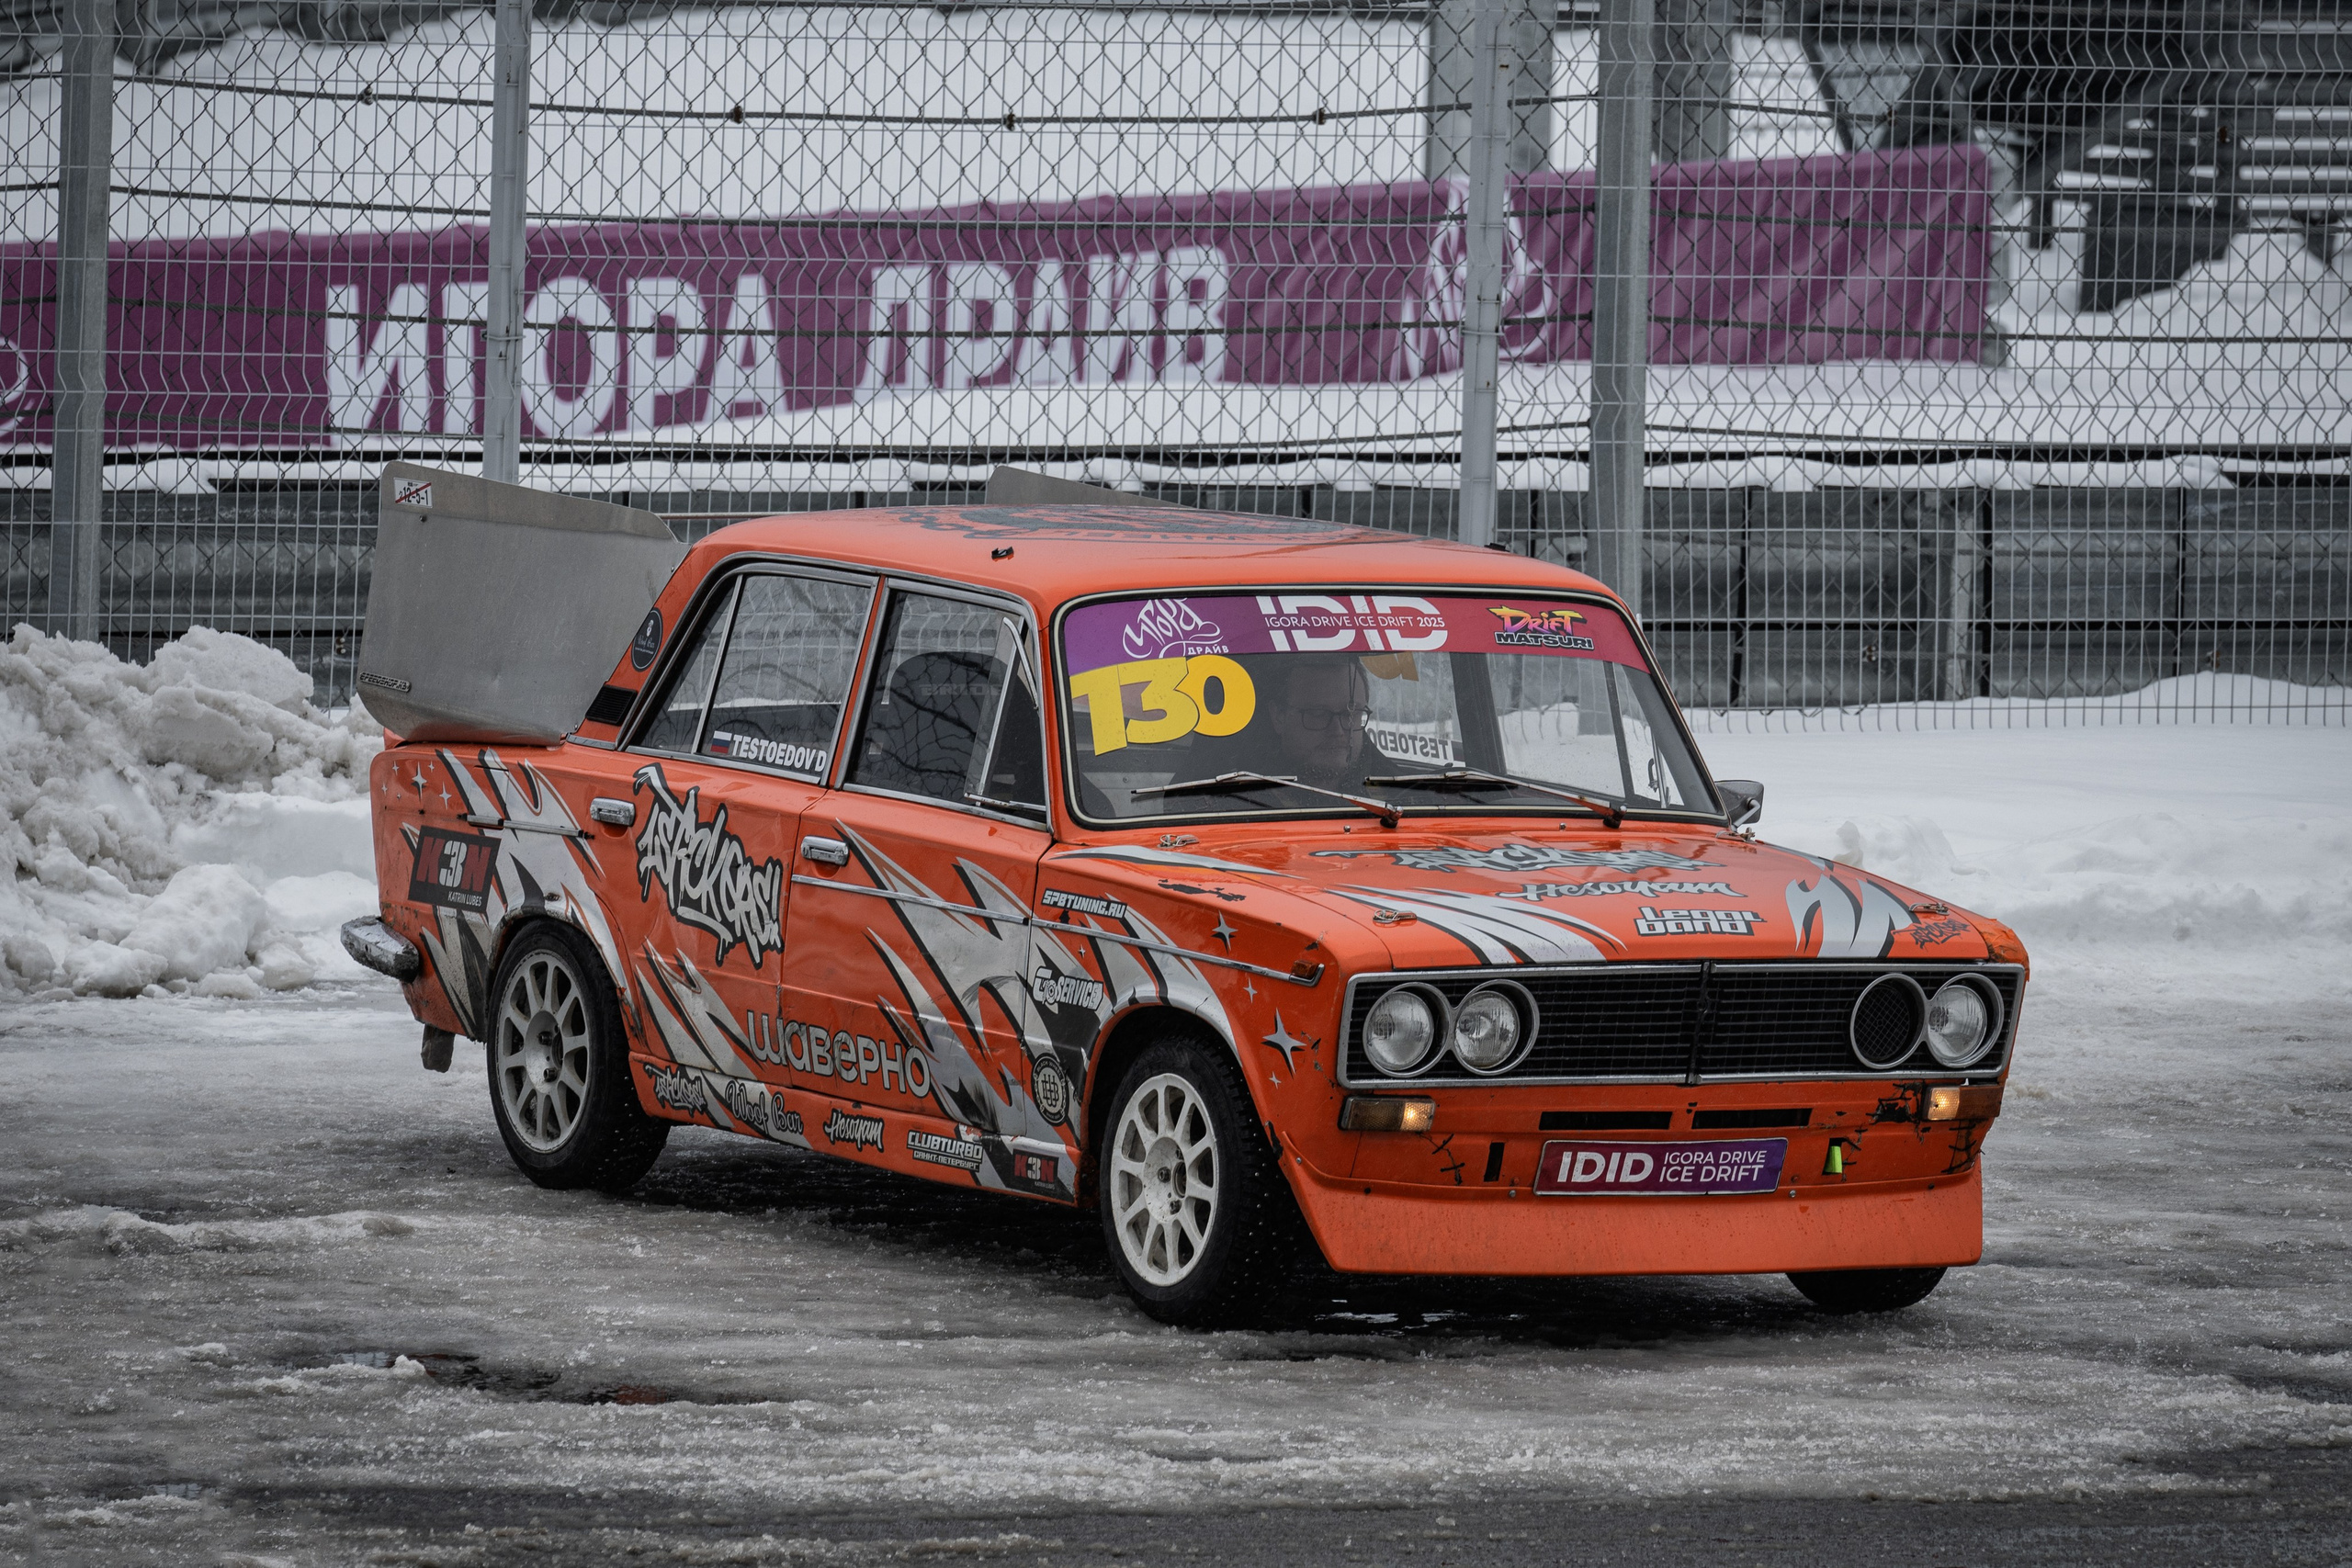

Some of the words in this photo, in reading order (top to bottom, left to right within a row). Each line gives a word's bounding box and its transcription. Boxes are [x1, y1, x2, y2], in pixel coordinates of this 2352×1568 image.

[325, 275, 787, 439] ИГОРА
[853, 245, 1231, 400] ДРАЙВ
[1265, 616, 1311, 627] IGORA
[1311, 616, 1352, 627] DRIVE
[1354, 616, 1376, 627] ICE
[1378, 616, 1414, 627] DRIFT
[1417, 616, 1445, 627] 2025
[1187, 644, 1229, 655] ДРАЙВ
[1495, 632, 1595, 650] MATSURI
[1069, 654, 1257, 756] 130
[732, 734, 817, 770] TESTOEDOV
[814, 750, 827, 772] D
[416, 836, 492, 892] K3N
[447, 891, 466, 904] KATRIN
[466, 893, 482, 907] LUBES
[725, 1078, 768, 1134] Woof
[771, 1090, 804, 1135] Bar
[908, 1131, 983, 1159] CLUBTURBO
[1664, 1152, 1714, 1165] IGORA
[1719, 1150, 1767, 1164] DRIVE
[1014, 1154, 1055, 1183] K3N
[1557, 1151, 1654, 1182] IDID
[1659, 1167, 1695, 1182] ICE
[1700, 1165, 1764, 1182] DRIFT
